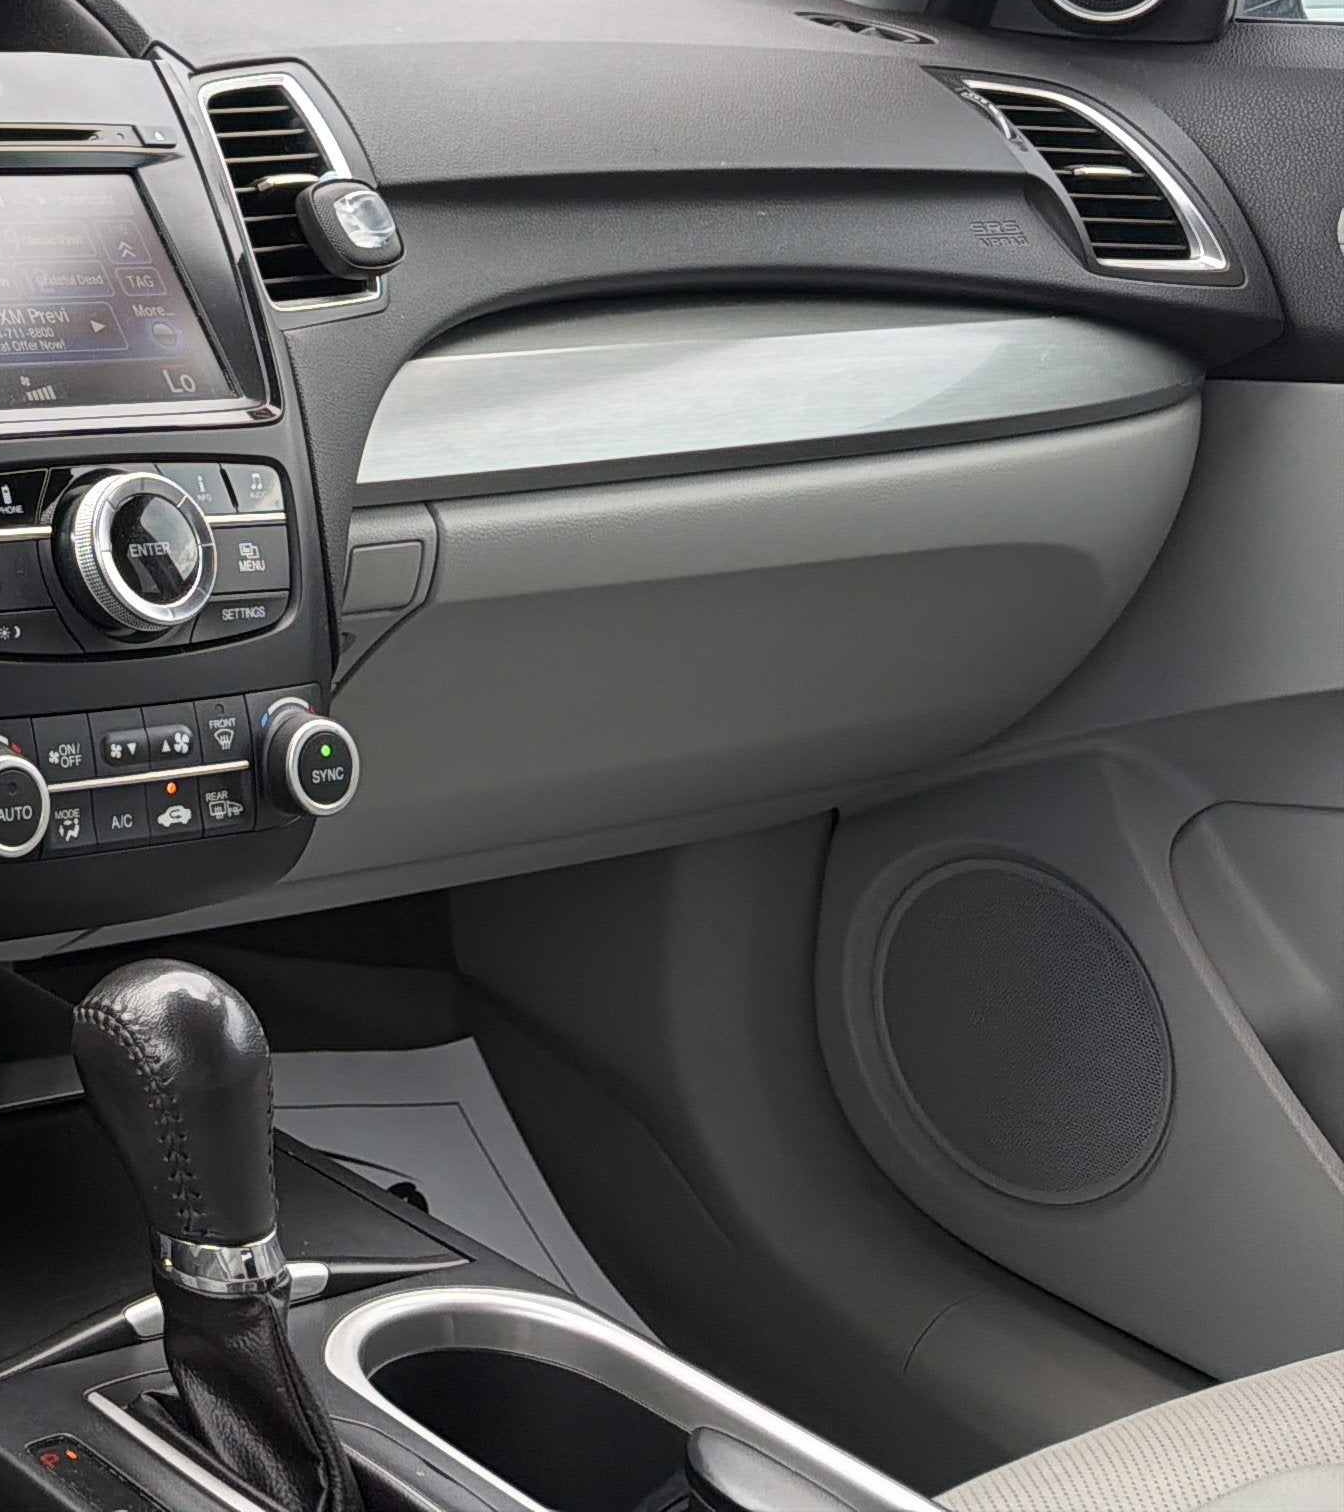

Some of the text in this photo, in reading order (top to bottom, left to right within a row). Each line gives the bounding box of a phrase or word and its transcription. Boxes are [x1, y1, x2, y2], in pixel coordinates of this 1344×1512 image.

[970, 219, 1020, 233] SRS
[125, 275, 155, 288] TAG
[26, 307, 70, 324] Previ
[11, 340, 38, 352] Offer
[163, 369, 196, 393] Lo
[129, 542, 171, 558] ENTER
[238, 559, 265, 572] MENU
[221, 606, 266, 621] SETTINGS
[208, 717, 236, 729] FRONT
[60, 754, 82, 768] OFF
[312, 767, 344, 784] SYNC
[205, 791, 228, 802] REAR
[54, 808, 81, 820] MODE
[111, 814, 133, 830] A/C
